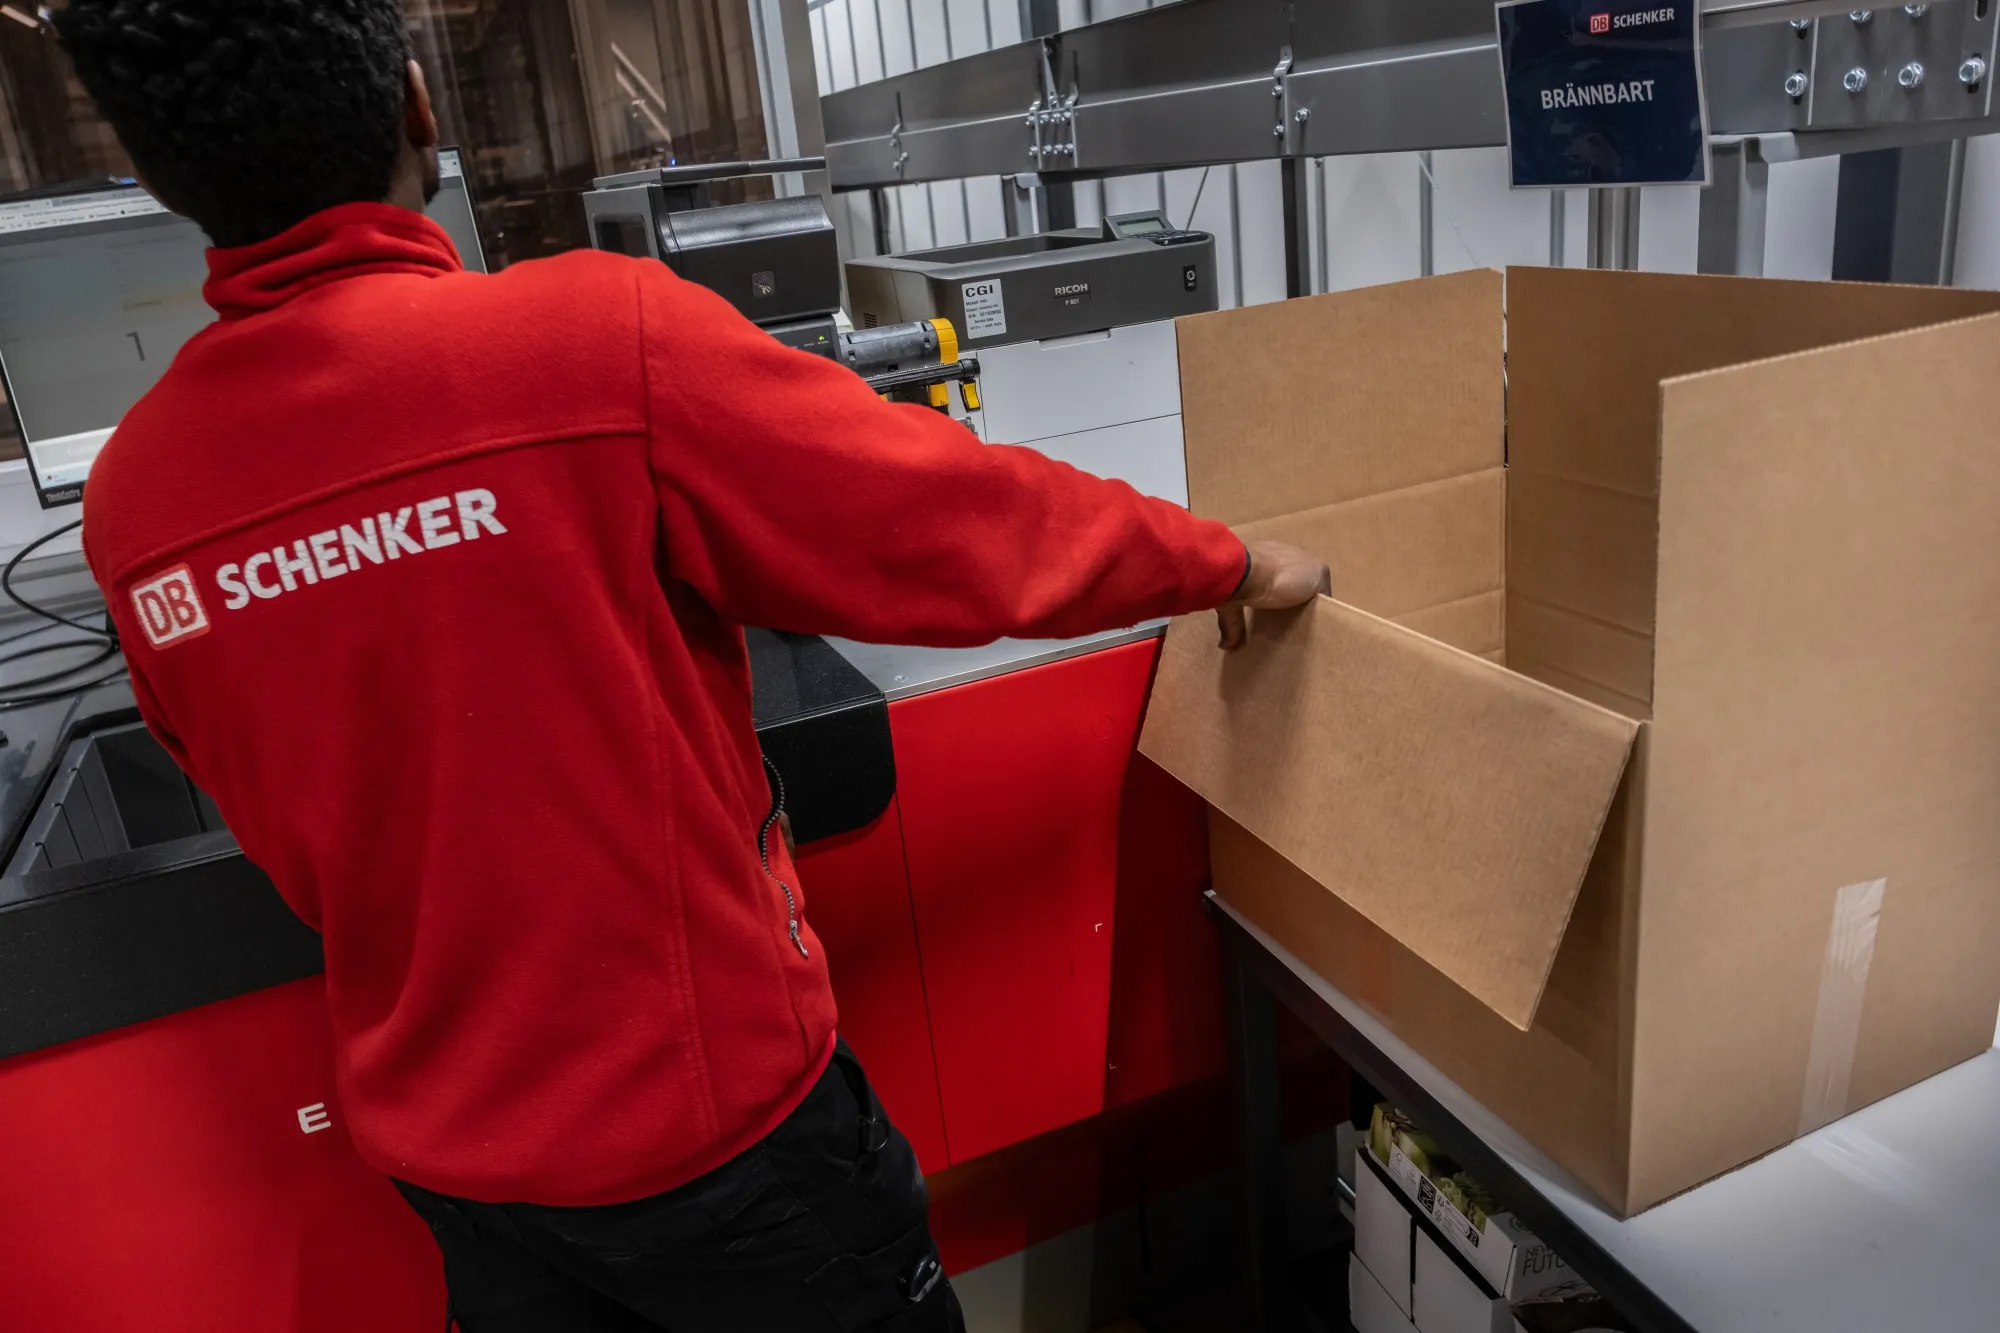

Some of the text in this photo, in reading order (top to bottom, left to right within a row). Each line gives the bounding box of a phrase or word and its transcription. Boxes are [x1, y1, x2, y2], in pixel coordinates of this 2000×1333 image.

[1591, 8, 1675, 33] DB SCHENKER
[1540, 80, 1655, 109] BRÄNNBART
[965, 285, 993, 297] CGI
[1054, 283, 1088, 296] RICOH
[133, 488, 508, 644] DB SCHENKER
